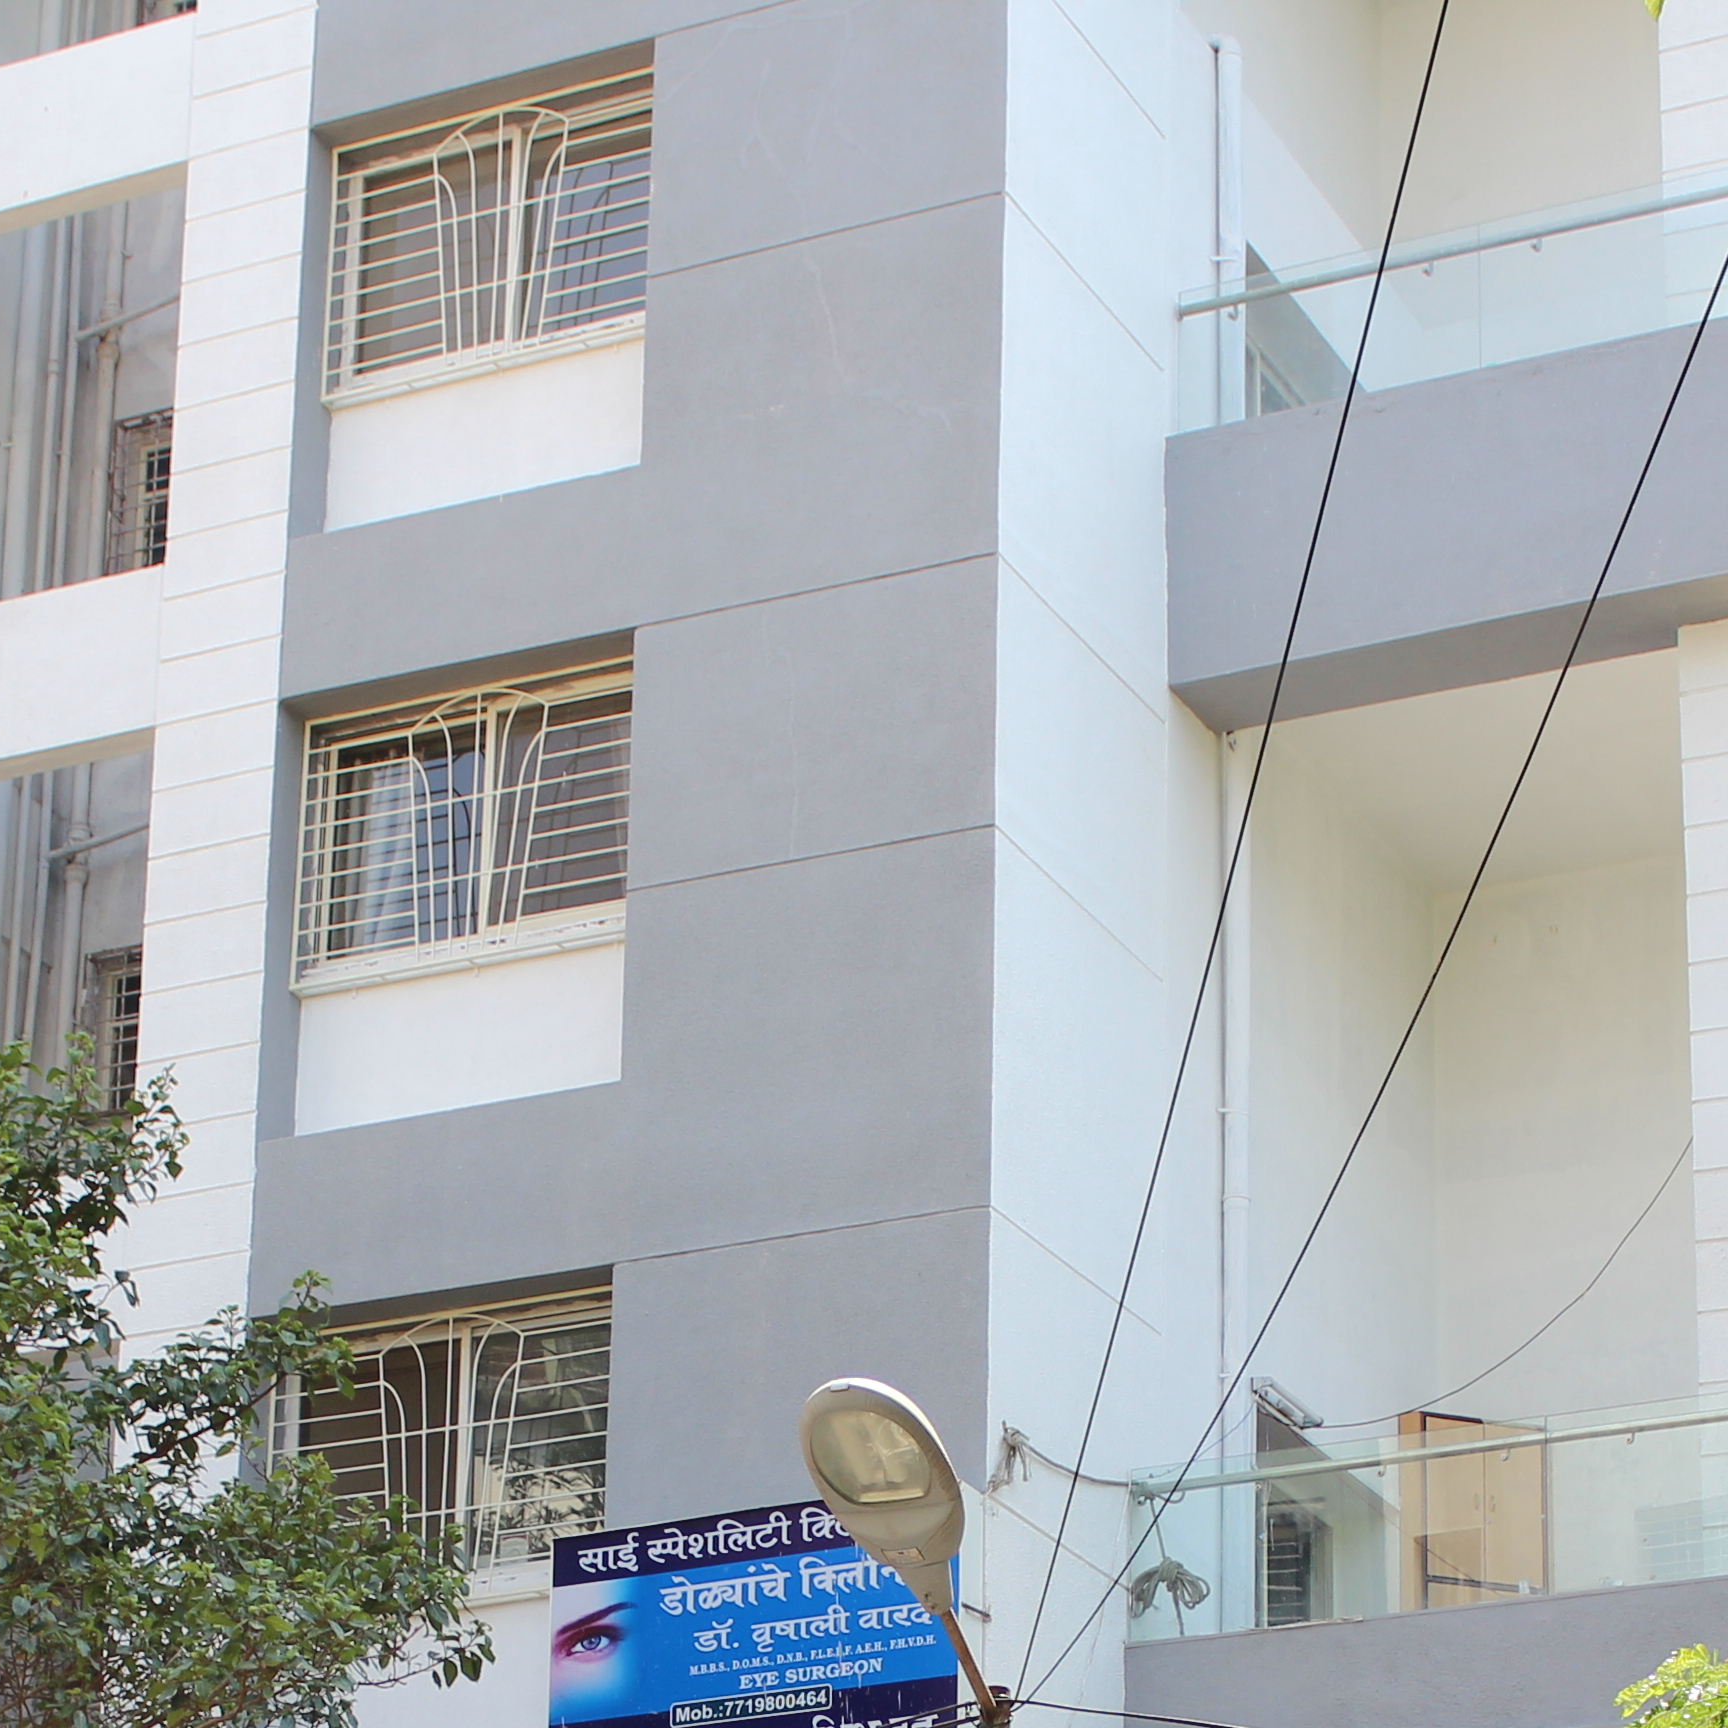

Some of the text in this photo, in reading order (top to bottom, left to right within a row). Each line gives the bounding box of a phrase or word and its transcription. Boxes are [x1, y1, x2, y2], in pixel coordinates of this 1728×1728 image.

[578, 1532, 639, 1573] साई
[647, 1511, 792, 1563] स्पेशलिटी
[659, 1562, 791, 1615] डोळ्यांचे
[694, 1618, 739, 1652] डॉ.
[751, 1604, 850, 1653] वृषाली
[739, 1657, 883, 1690] EYE SURGEON
